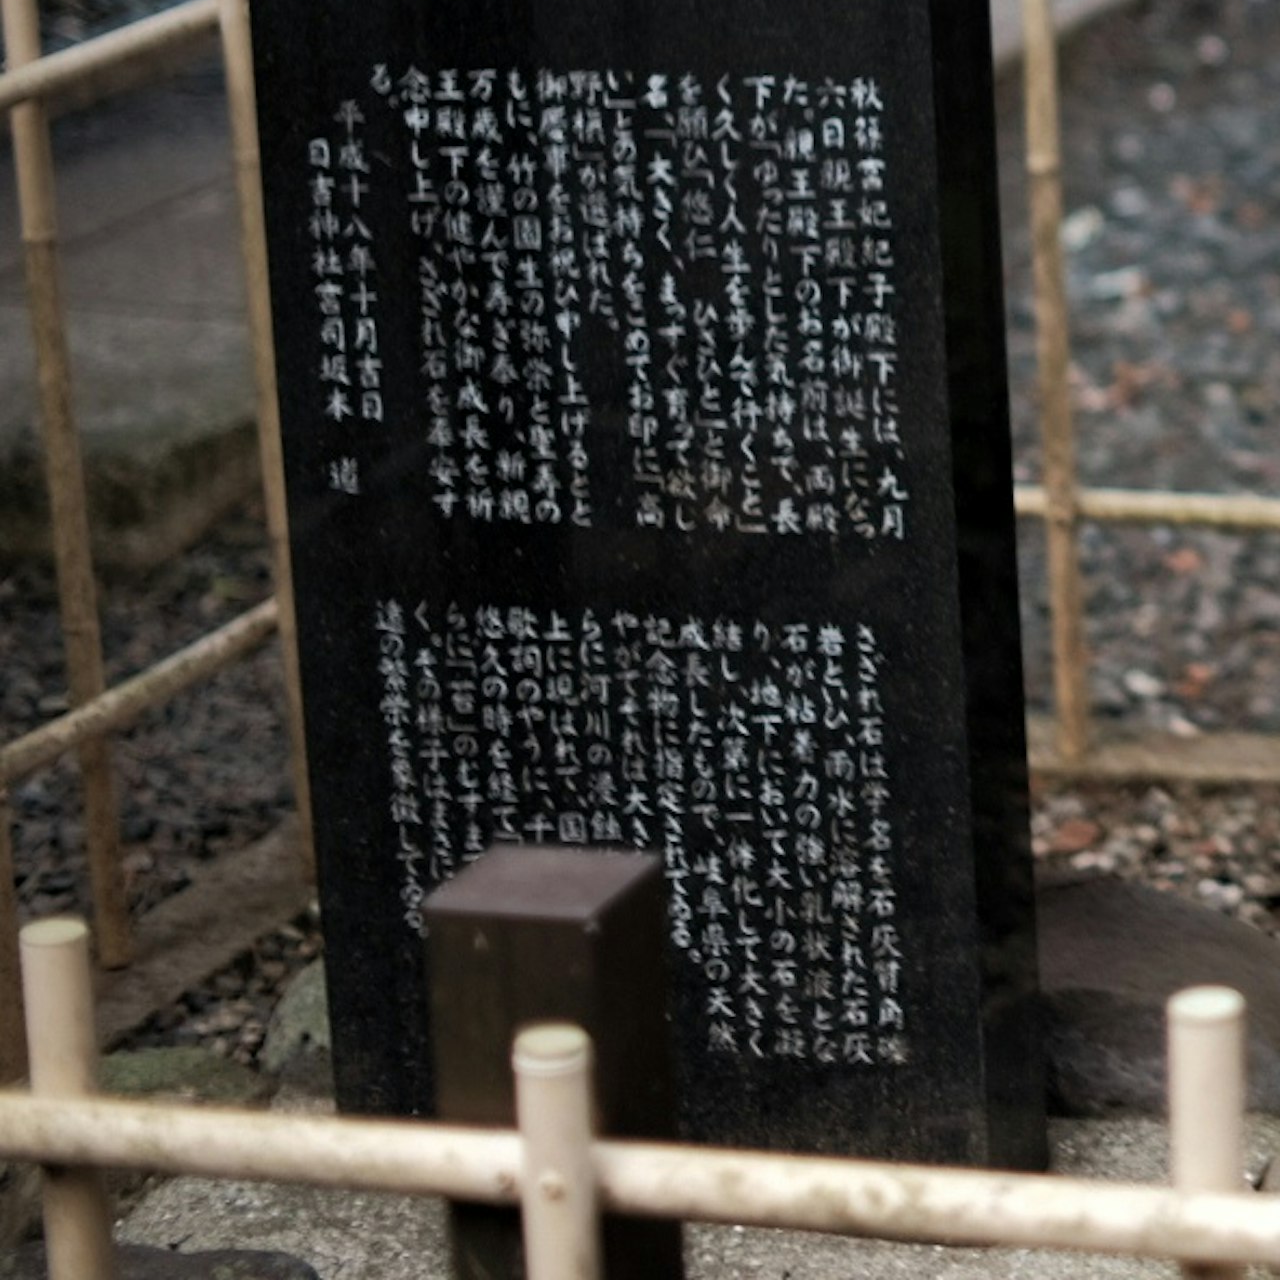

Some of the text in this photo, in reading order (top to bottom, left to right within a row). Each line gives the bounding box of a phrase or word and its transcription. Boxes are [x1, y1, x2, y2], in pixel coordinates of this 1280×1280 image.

[309, 138, 351, 420] 日吉神社宮司坂本
[333, 98, 384, 422] 平成十八年十月吉日
